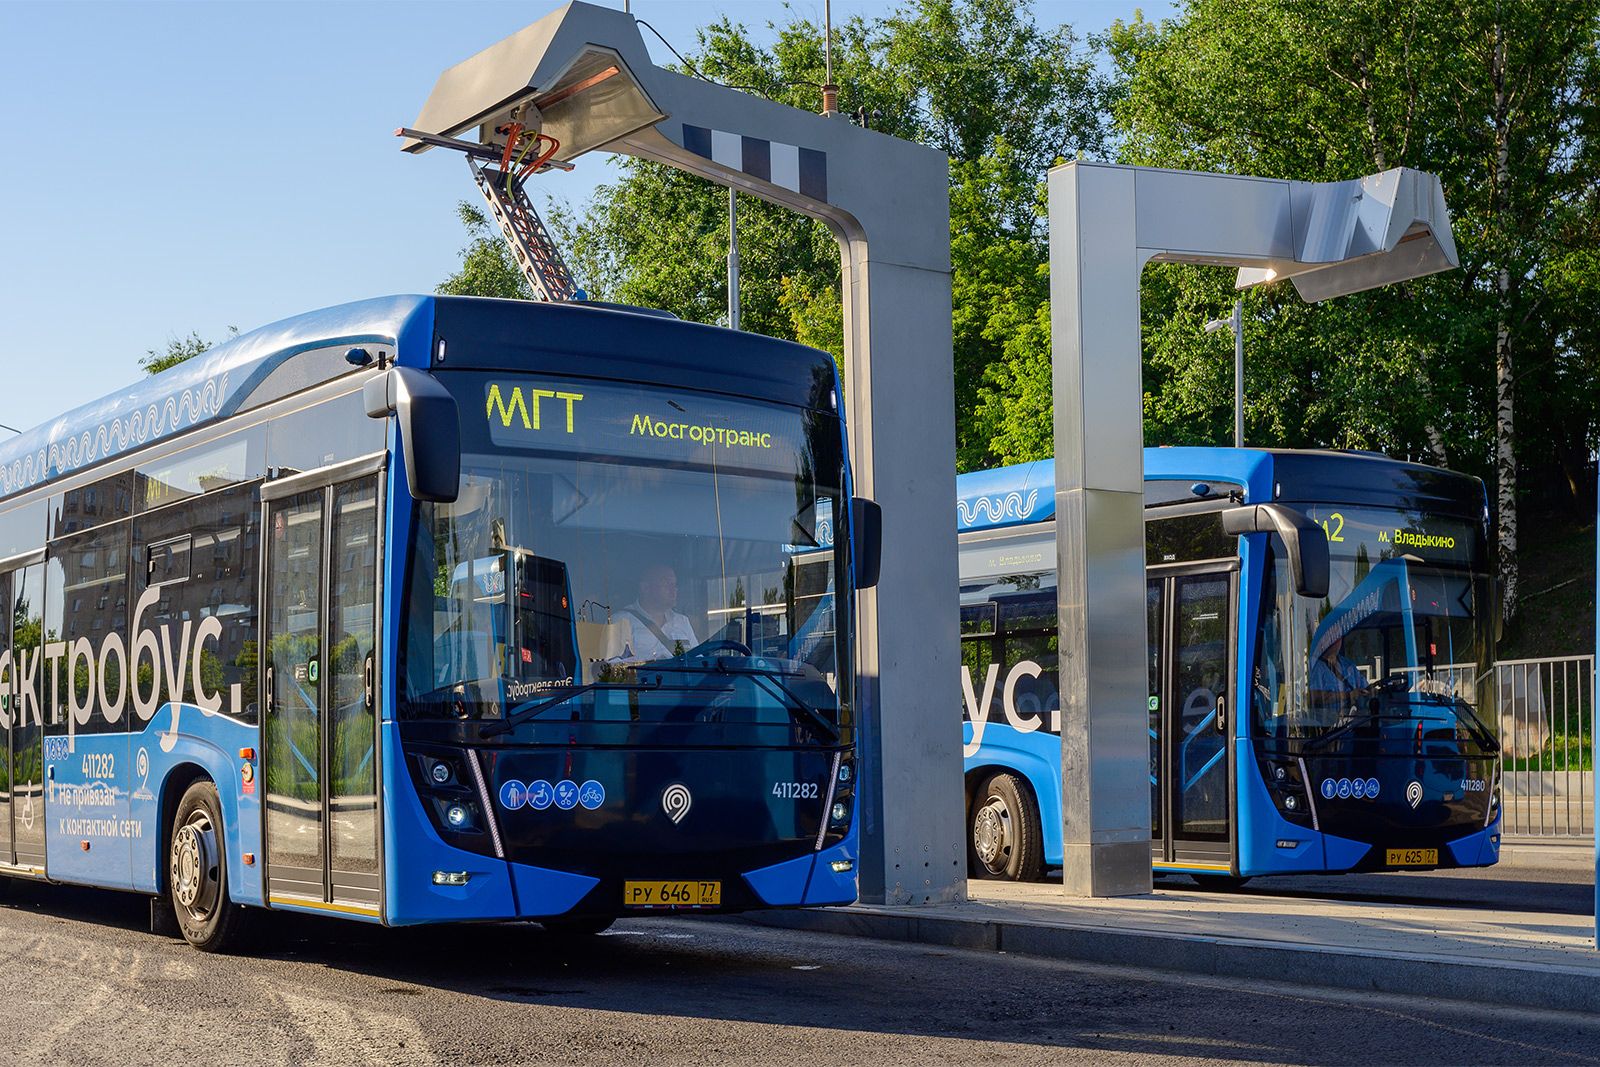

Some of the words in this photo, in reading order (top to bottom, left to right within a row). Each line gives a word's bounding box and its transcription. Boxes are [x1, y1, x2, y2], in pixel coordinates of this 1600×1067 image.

[486, 384, 583, 433] МГТ
[630, 414, 771, 448] Мосгортранс
[1394, 529, 1455, 549] Владыкино
[82, 753, 114, 778] 411282
[772, 782, 818, 799] 411282
[1460, 779, 1485, 791] 411280
[59, 784, 71, 805] Не
[73, 787, 115, 811] привязан
[60, 818, 66, 835] к
[67, 814, 119, 837] контактной
[120, 820, 142, 838] сети
[1404, 851, 1422, 863] 625
[660, 884, 690, 901] 646
[700, 883, 715, 896] 77
